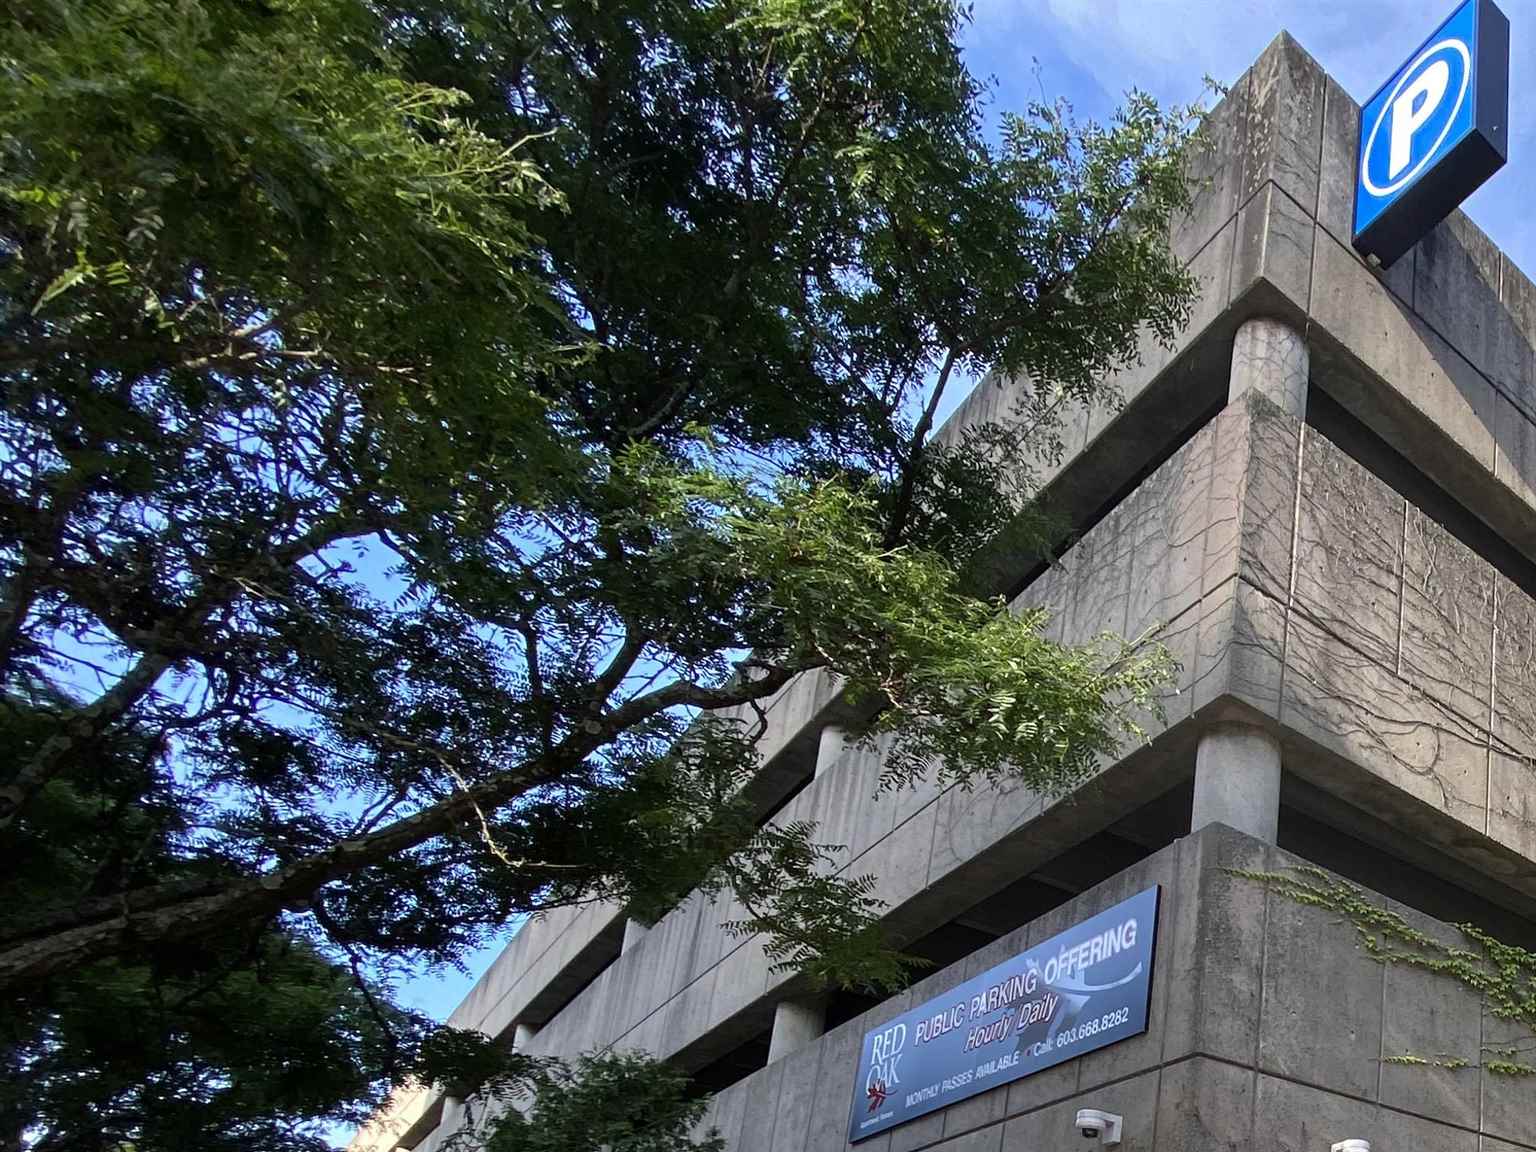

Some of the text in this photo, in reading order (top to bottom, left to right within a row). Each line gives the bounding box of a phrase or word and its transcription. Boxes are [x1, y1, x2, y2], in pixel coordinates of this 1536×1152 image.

[1388, 60, 1449, 181] P
[914, 918, 1138, 1046] PUBLIC PARKING OFFERING
[964, 992, 1059, 1051] Hourly Daily
[865, 1053, 904, 1096] OAK
[871, 1023, 907, 1066] RED
[905, 1080, 941, 1108] MONTHLY
[941, 1069, 973, 1094] PASSES
[974, 1050, 1021, 1081] AVAILABLE
[1056, 1006, 1129, 1048] 603.668.8282
